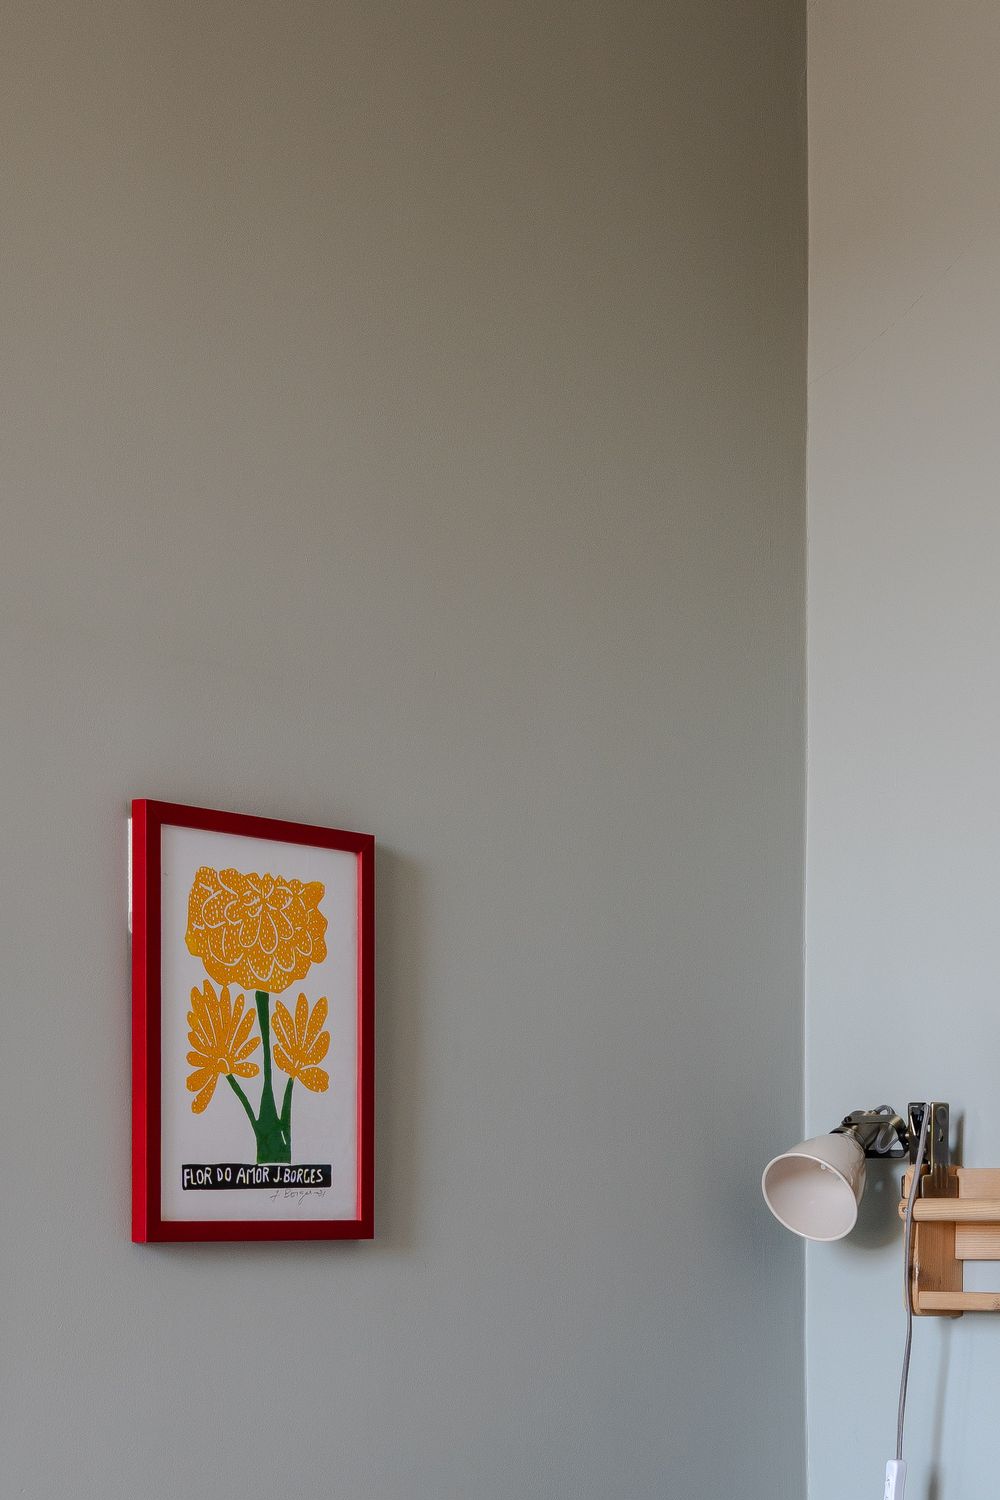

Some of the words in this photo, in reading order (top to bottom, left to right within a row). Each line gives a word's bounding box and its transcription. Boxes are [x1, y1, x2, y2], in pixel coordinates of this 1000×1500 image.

[183, 1166, 213, 1188] FLOR
[216, 1167, 232, 1182] DO
[236, 1166, 270, 1185] AMOR
